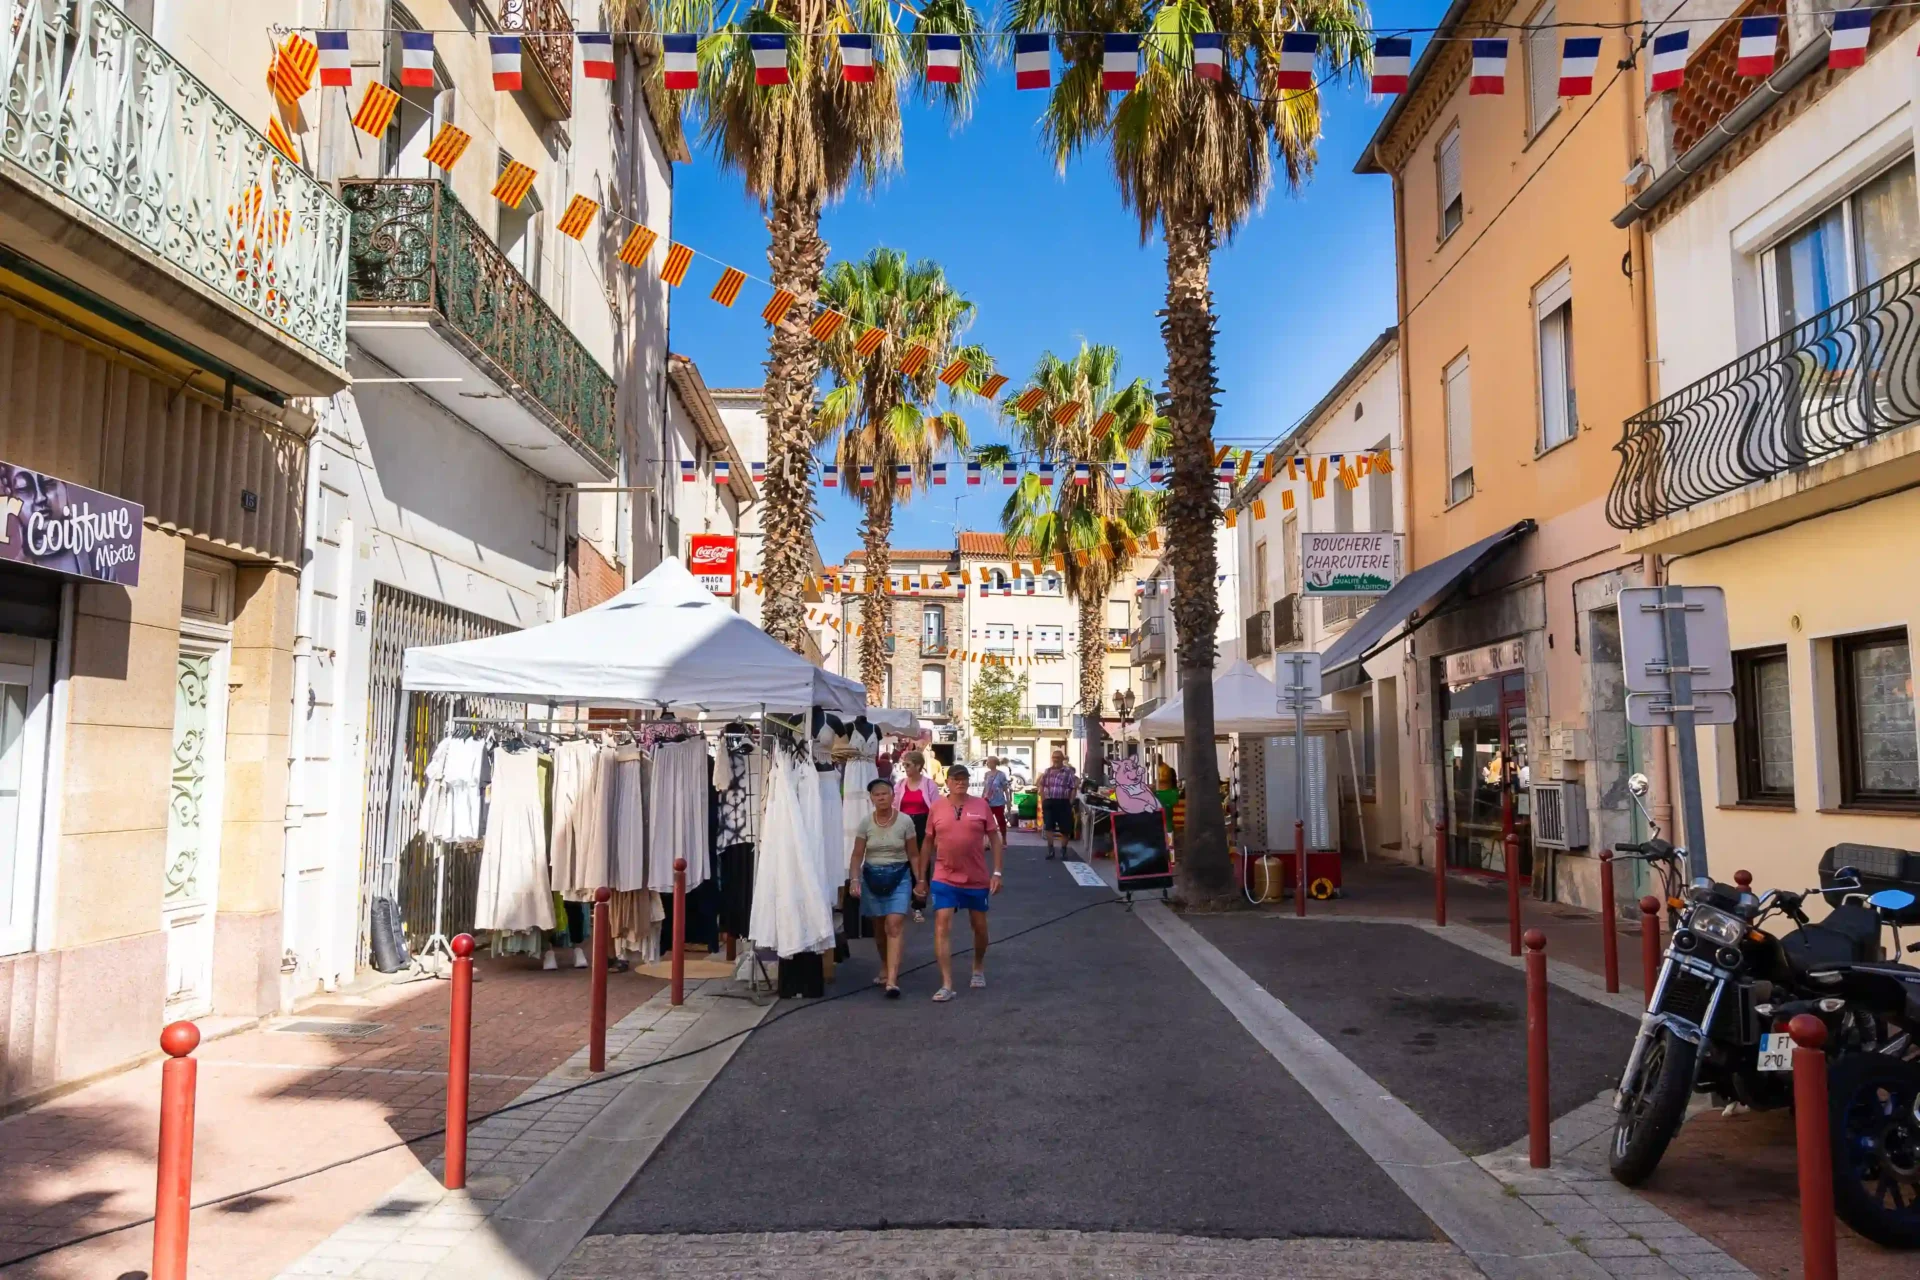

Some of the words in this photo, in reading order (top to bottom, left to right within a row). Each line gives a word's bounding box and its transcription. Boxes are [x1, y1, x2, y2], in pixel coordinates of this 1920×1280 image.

[27, 502, 132, 556] Coiffure
[1312, 538, 1382, 552] BOUCHERIE
[95, 543, 136, 571] Mixte
[1306, 555, 1390, 569] CHARCUTERIE
[1604, 582, 1613, 596] 14
